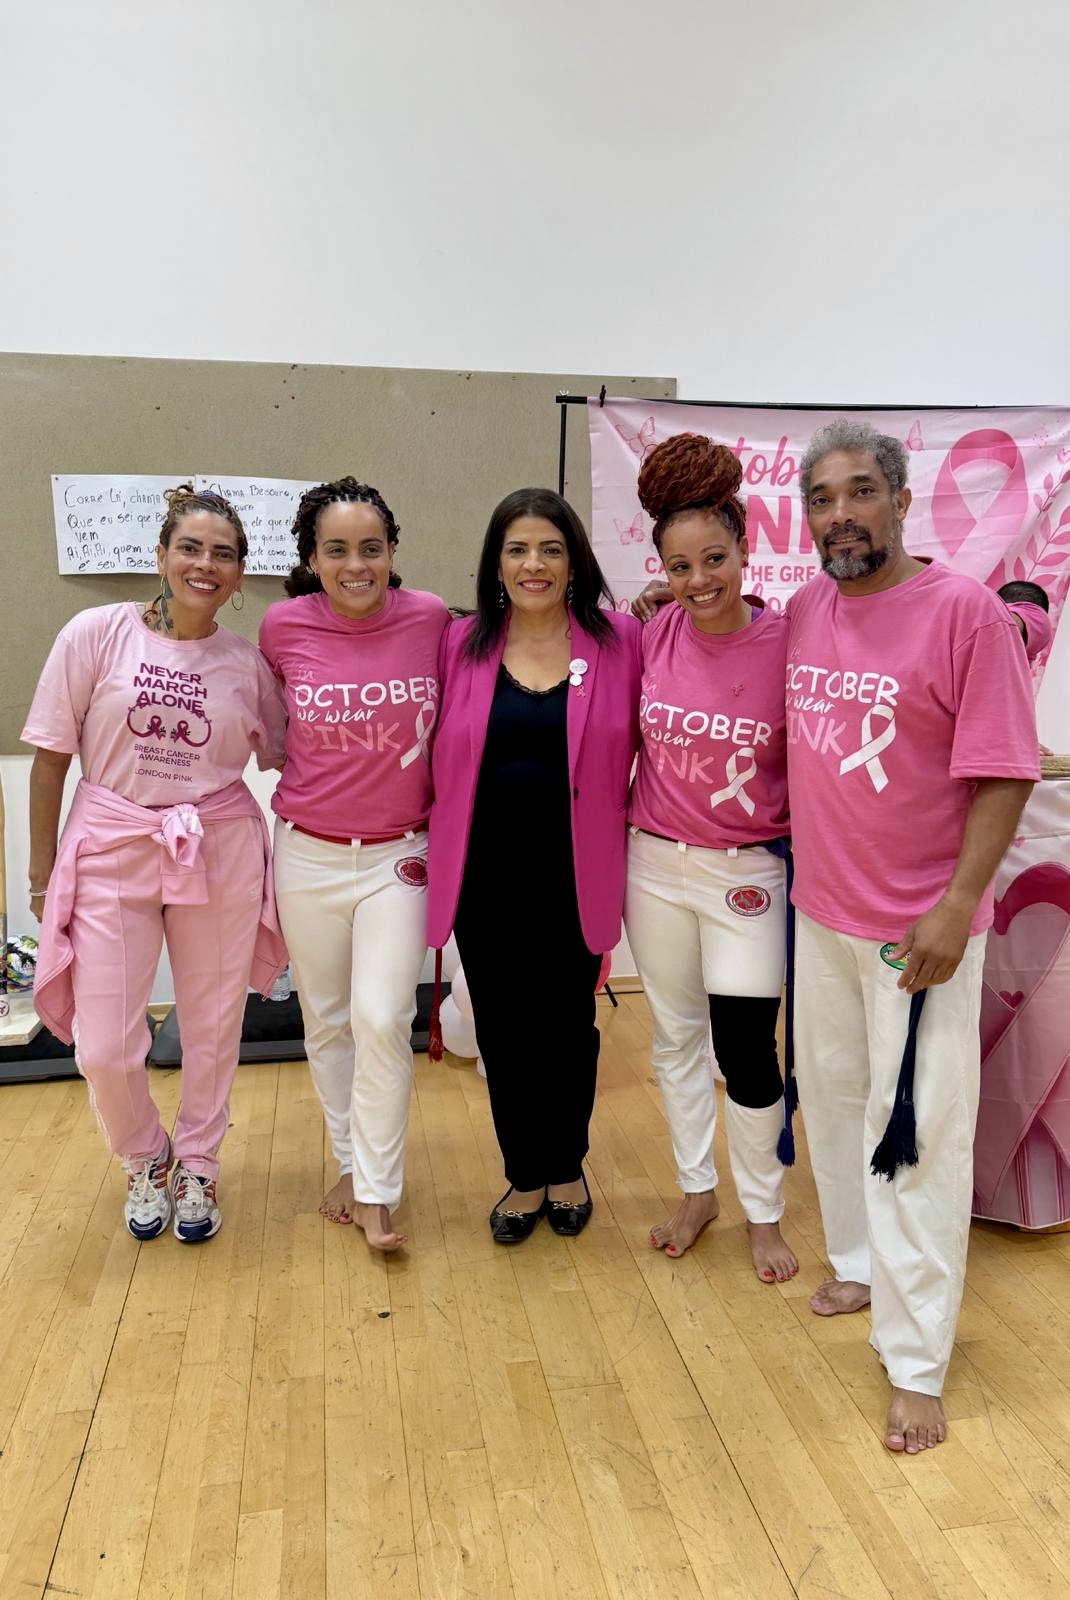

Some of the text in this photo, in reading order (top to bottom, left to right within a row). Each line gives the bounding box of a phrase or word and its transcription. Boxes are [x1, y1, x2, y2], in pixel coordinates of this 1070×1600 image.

[67, 513, 93, 531] Que
[100, 515, 113, 526] eu
[117, 513, 133, 524] sei
[137, 514, 152, 528] que
[113, 544, 142, 562] quem
[126, 557, 157, 568] Beso
[779, 565, 818, 582] GRE
[140, 662, 202, 685] NEVER
[133, 676, 207, 699] MARCH
[294, 676, 438, 707] OCTOBER
[136, 691, 204, 712] ALONE
[793, 695, 836, 714] wear
[325, 708, 377, 723] wear
[299, 722, 401, 752] PINK
[650, 728, 696, 748] wear
[787, 711, 847, 757] INK
[134, 744, 200, 761] BREAST CANCER
[139, 753, 192, 767] AWARENESS
[135, 768, 193, 783] LONDON PINK
